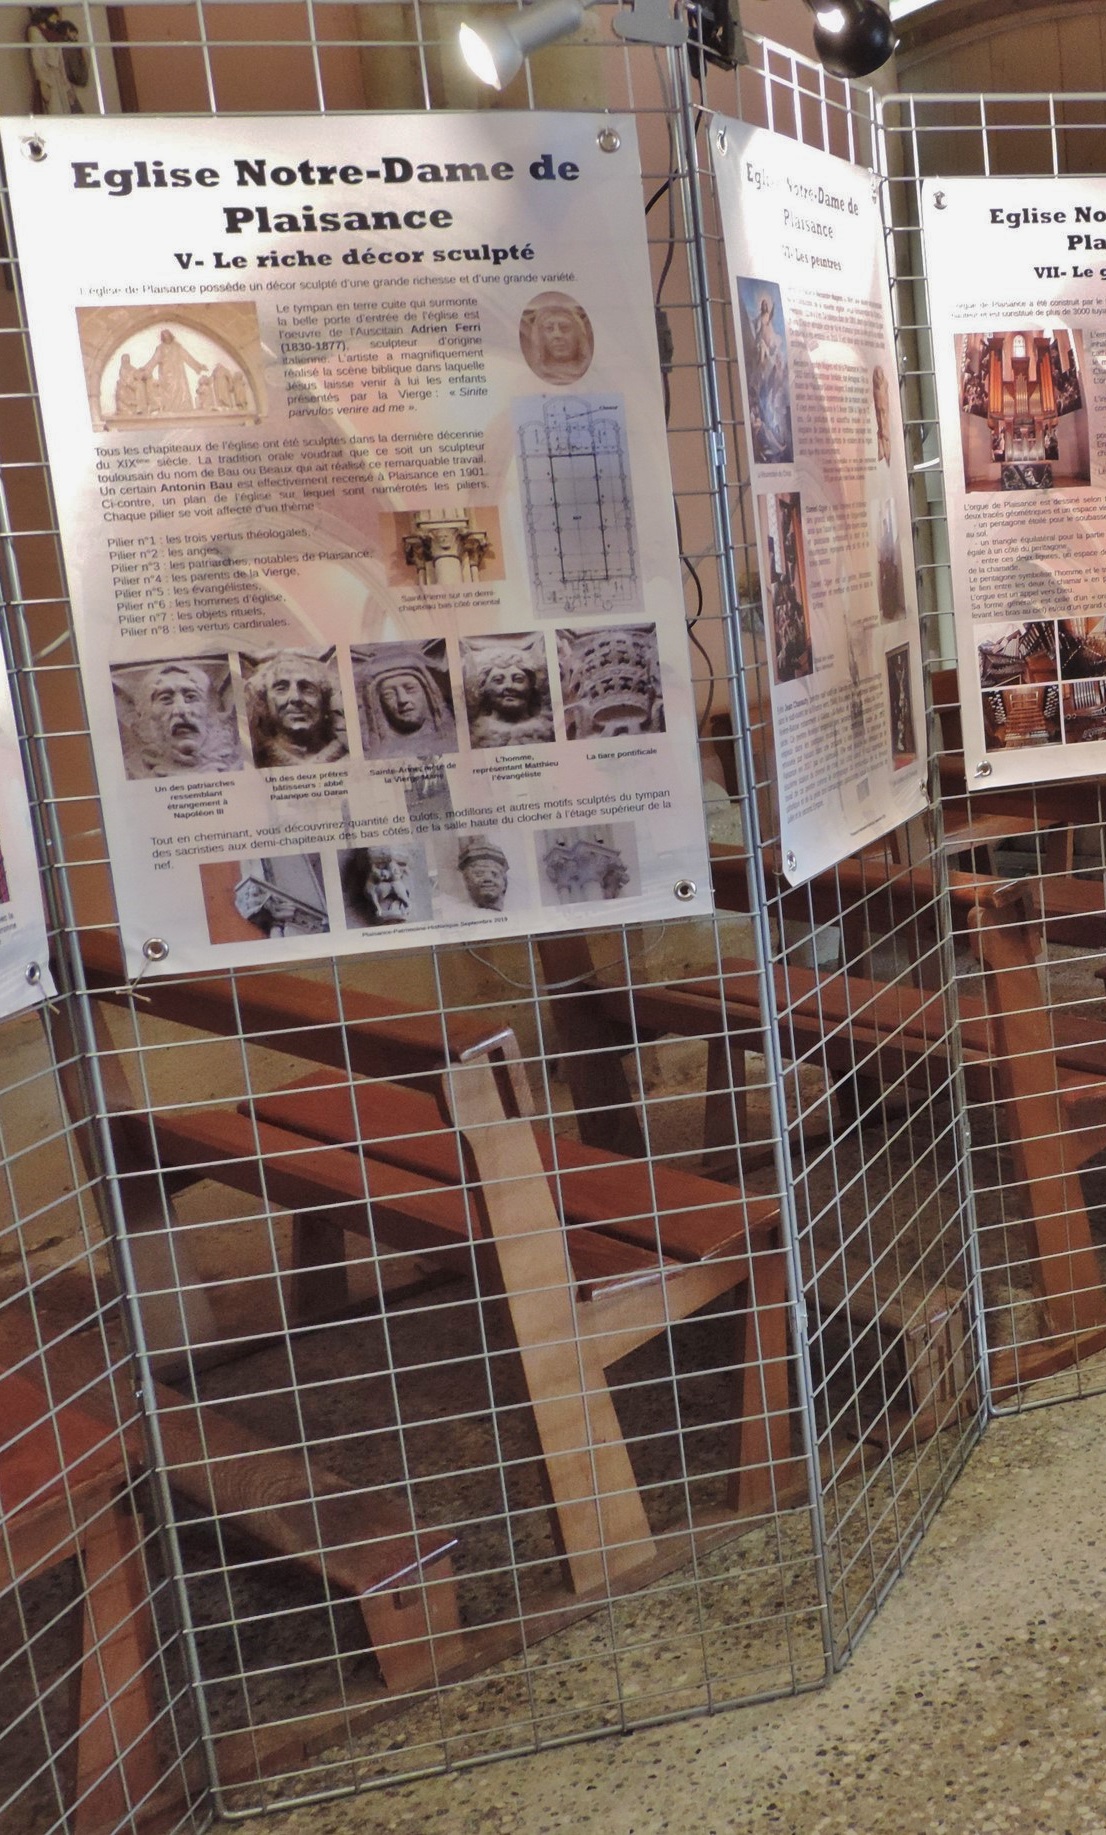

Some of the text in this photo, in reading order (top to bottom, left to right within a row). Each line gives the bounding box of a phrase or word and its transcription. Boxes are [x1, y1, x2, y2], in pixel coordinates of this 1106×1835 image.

[71, 154, 579, 196] Eglise Notre-Dame de
[848, 197, 859, 216] de
[223, 206, 453, 233] Plaisance
[784, 208, 833, 239] Plaisance
[990, 208, 1066, 228] Eglise
[174, 243, 535, 269] V- Le riche décor sculpté
[811, 255, 842, 271] peintres
[1034, 267, 1066, 278] VII-
[1072, 266, 1093, 278] Le
[199, 282, 246, 294] possède
[265, 281, 295, 290] décor
[299, 280, 337, 291] sculpté
[340, 279, 369, 288] d'une
[372, 278, 409, 289] grande
[412, 277, 455, 286] richesse
[472, 275, 500, 284] d'une
[503, 274, 537, 285] grande
[276, 304, 289, 313] Le
[293, 303, 333, 314] tympan
[353, 302, 377, 310] terre
[380, 300, 406, 309] cuite
[409, 299, 425, 310] qui
[429, 298, 477, 307] surmonte
[278, 311, 479, 326] la belle porte d'entrée de l'église est
[279, 323, 481, 338] l'oeuvre de l'Auscitain Adrien Ferri
[370, 338, 417, 350] sculpteur
[438, 335, 482, 347] d'origine
[322, 361, 484, 375] la scène biblique dans laquelle
[323, 374, 486, 388] laisse venir à lui les enfants
[288, 405, 333, 417] parvulos
[337, 404, 369, 413] venire
[372, 404, 385, 412] ad
[95, 430, 483, 456] Tous les chapiteaux de l'église ont été sculptés dans la dernière décennie
[99, 486, 116, 495] Un
[119, 484, 156, 494] certain
[160, 481, 205, 492] Antonin
[209, 480, 232, 489] Bau
[388, 470, 438, 481] Plaisance
[107, 537, 134, 547] Pilier
[165, 535, 181, 544] les
[184, 534, 207, 543] trois
[210, 533, 243, 542] vertus
[120, 627, 147, 636] Pilier
[178, 624, 194, 633] les
[196, 622, 229, 632] vertus
[597, 751, 615, 759] tiare
[617, 748, 657, 759] pontificale
[472, 760, 558, 775] représentant Matthieu
[491, 771, 541, 782] l'évangéliste
[186, 780, 235, 791] patriarches
[151, 835, 173, 846] Tout
[255, 827, 281, 836] vous
[543, 798, 572, 808] motifs
[576, 794, 616, 808] sculptés
[619, 792, 631, 801] du
[173, 809, 214, 820] Napoléon
[250, 832, 335, 851] demi-chapiteaux
[360, 828, 379, 838] bas
[444, 820, 467, 830] salle
[470, 817, 498, 827] haute
[501, 815, 513, 824] du
[517, 811, 551, 823] clocher
[564, 807, 597, 820] l'étage
[600, 803, 644, 817] supérieur
[647, 801, 659, 810] de
